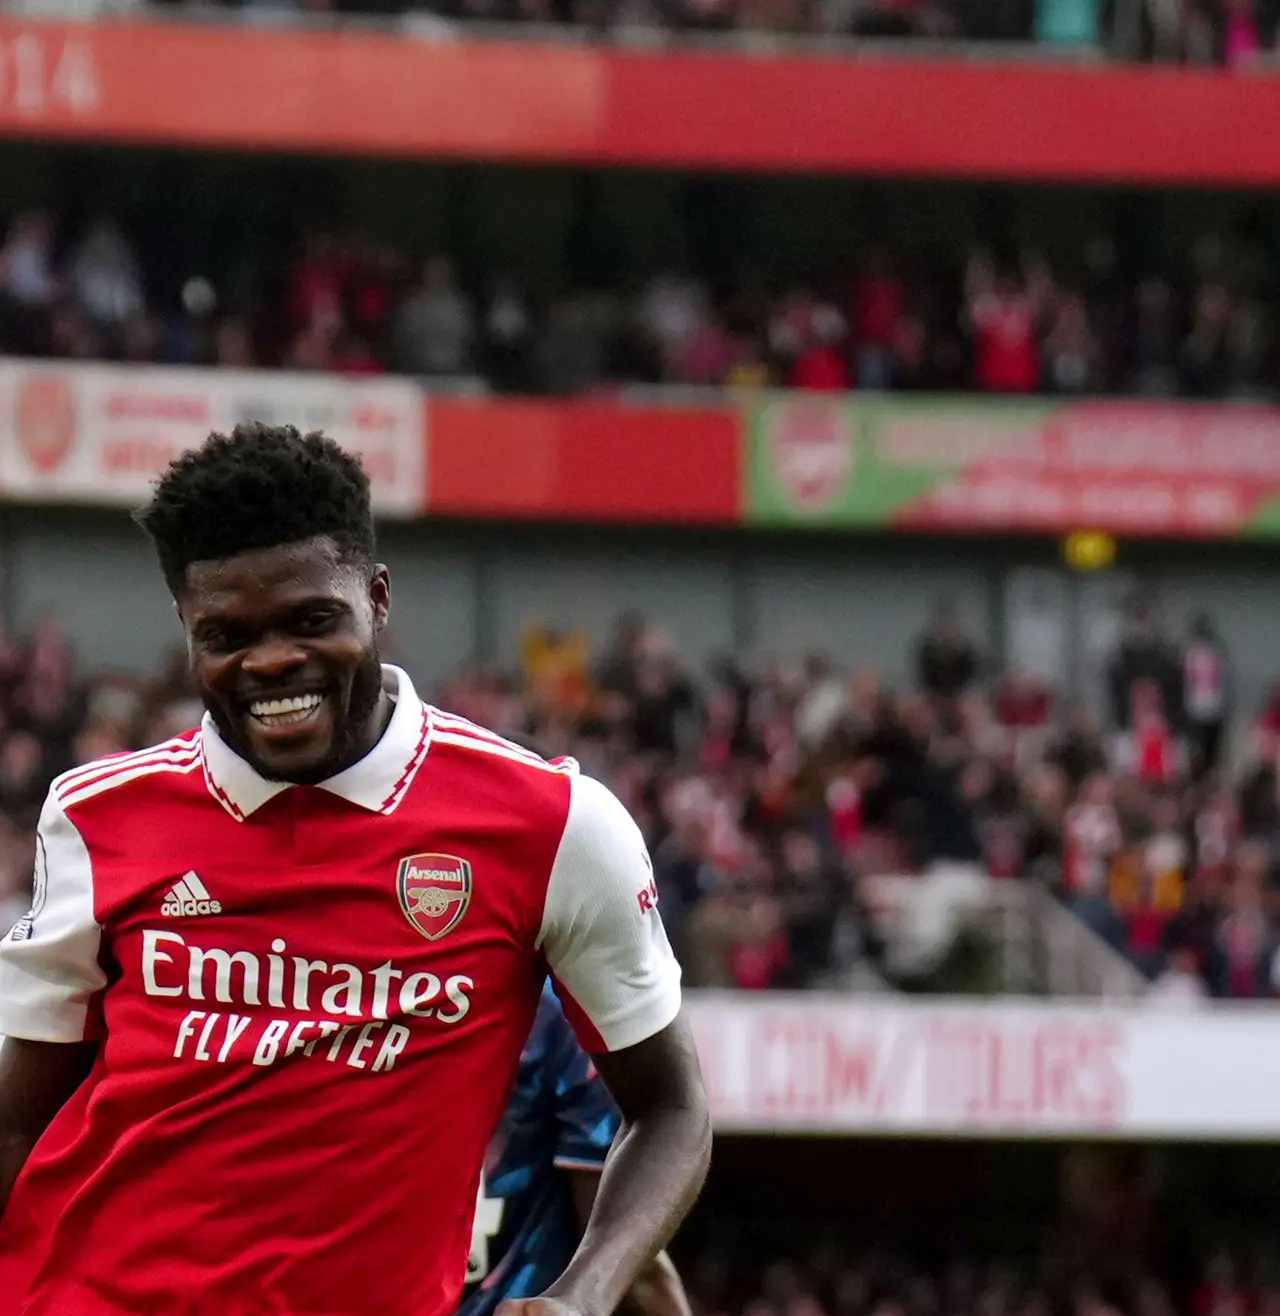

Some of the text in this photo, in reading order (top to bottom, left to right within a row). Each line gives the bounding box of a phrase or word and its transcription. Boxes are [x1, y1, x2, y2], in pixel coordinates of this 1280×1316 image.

[406, 865, 461, 883] Arsenal
[160, 898, 223, 917] adidas
[142, 928, 475, 1024] Emirates
[173, 1010, 411, 1073] FLY BETTER
